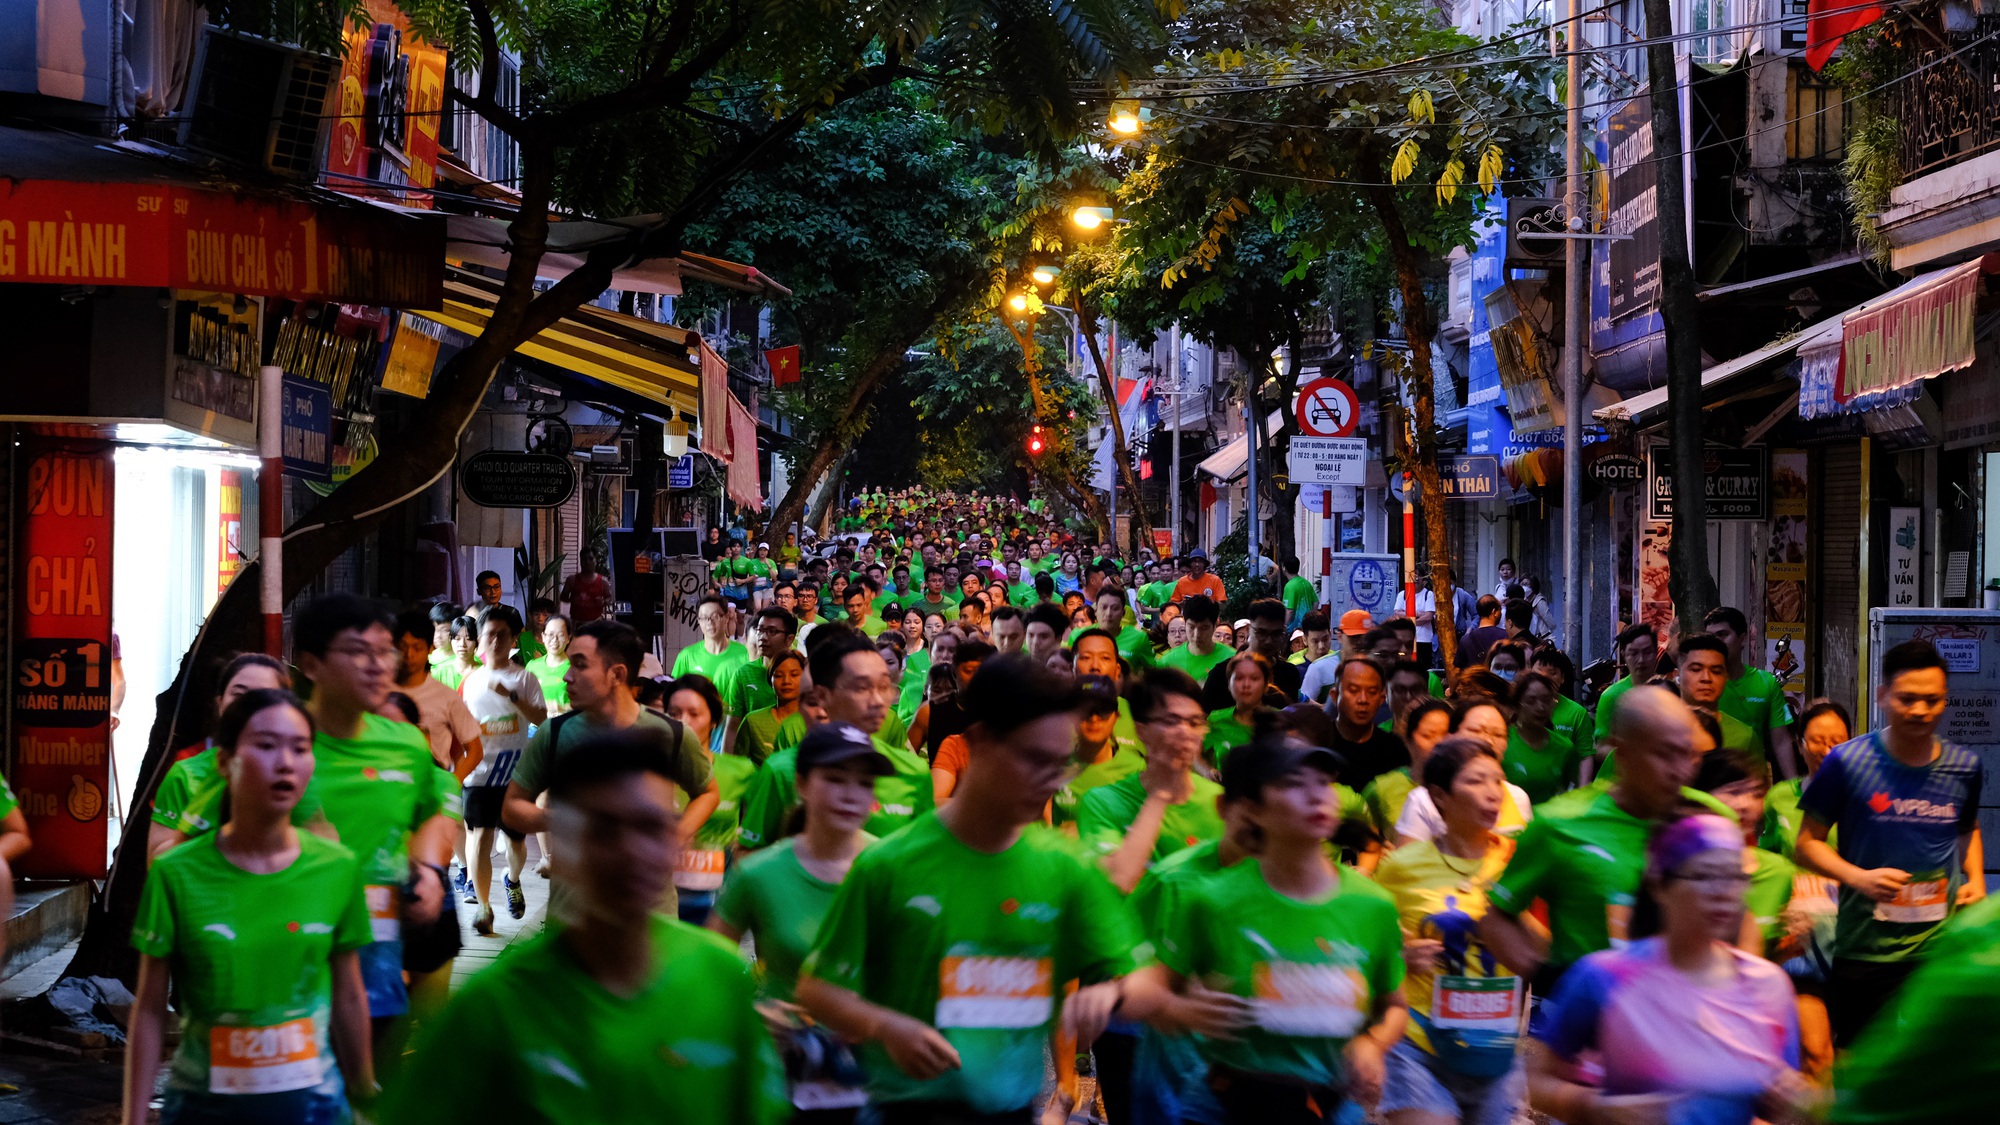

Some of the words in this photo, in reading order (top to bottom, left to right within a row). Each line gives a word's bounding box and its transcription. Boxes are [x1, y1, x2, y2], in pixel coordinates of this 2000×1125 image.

[27, 210, 126, 279] MÀNH
[187, 219, 228, 286] BÚN
[231, 216, 269, 290] CHẢ
[300, 213, 324, 295] 1
[296, 393, 313, 417] PHỐ
[473, 461, 494, 473] HANOI
[495, 461, 508, 473] OLD
[509, 462, 541, 474] QUARTER
[542, 463, 567, 475] TRAVEL
[1315, 463, 1333, 473] NGOẠI
[1334, 463, 1341, 473] LỆ
[1443, 460, 1471, 473] PHỐ
[1595, 465, 1643, 479] HOTEL
[480, 475, 503, 484] TOUR
[505, 476, 563, 485] INFORMATION
[1316, 472, 1340, 481] Except
[1457, 474, 1490, 493] THÁI
[26, 454, 105, 518] BÚN
[482, 484, 512, 493] MONEY
[513, 485, 559, 494] EXCHANGE
[1717, 476, 1760, 496] CURRY
[492, 493, 507, 501] SIM
[509, 494, 532, 502] CARD
[1897, 557, 1911, 569] TƯ
[26, 536, 102, 617] CHẢ
[1894, 571, 1914, 585] VẤN
[1896, 590, 1913, 605] LẮP
[76, 642, 101, 689] 1
[16, 690, 60, 713] HÀNG
[63, 690, 109, 713] MÀNH
[1962, 698, 1974, 709] LẠI
[1967, 710, 1985, 719] ĐIỆN
[1972, 718, 1990, 727] HIỂM
[1948, 728, 1967, 737] CHẾT
[19, 735, 107, 767] Number
[18, 789, 58, 817] One
[1892, 797, 1957, 818] VPBank
